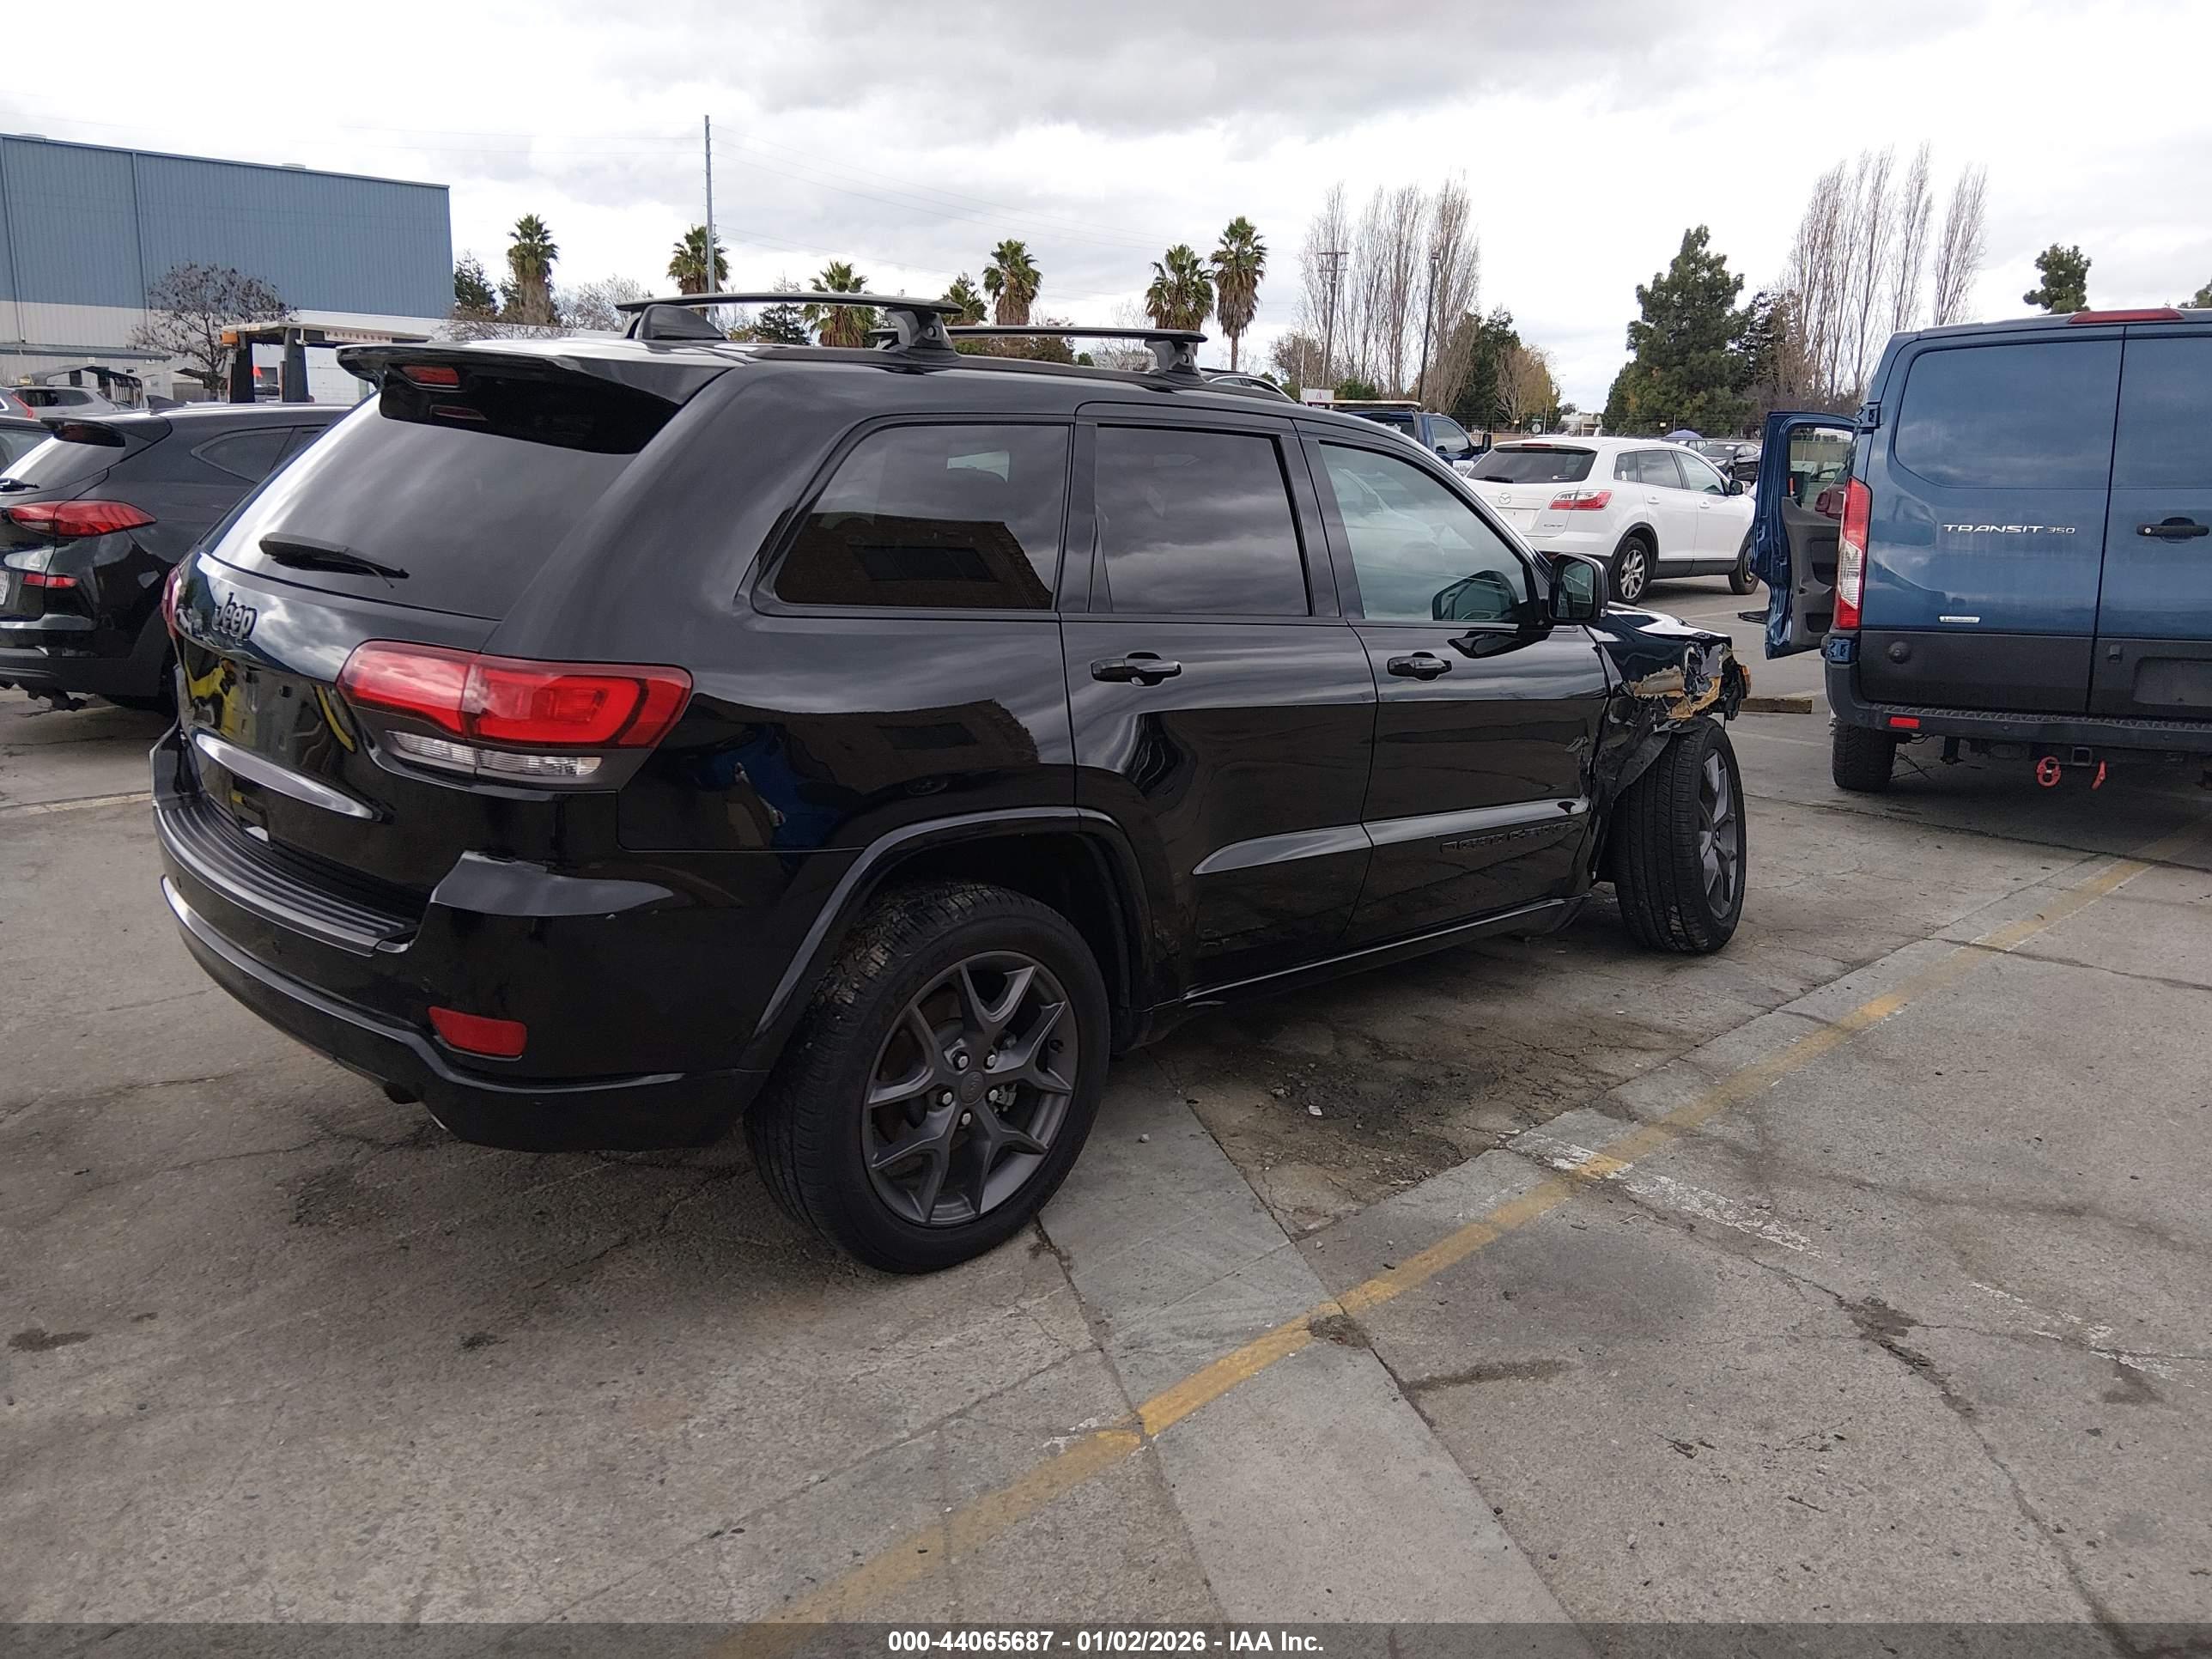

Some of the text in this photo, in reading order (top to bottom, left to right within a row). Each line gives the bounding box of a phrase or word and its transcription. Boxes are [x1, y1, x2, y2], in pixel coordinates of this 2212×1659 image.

[1942, 524, 2076, 535] TRANSIT 350
[211, 592, 258, 641] Jeep
